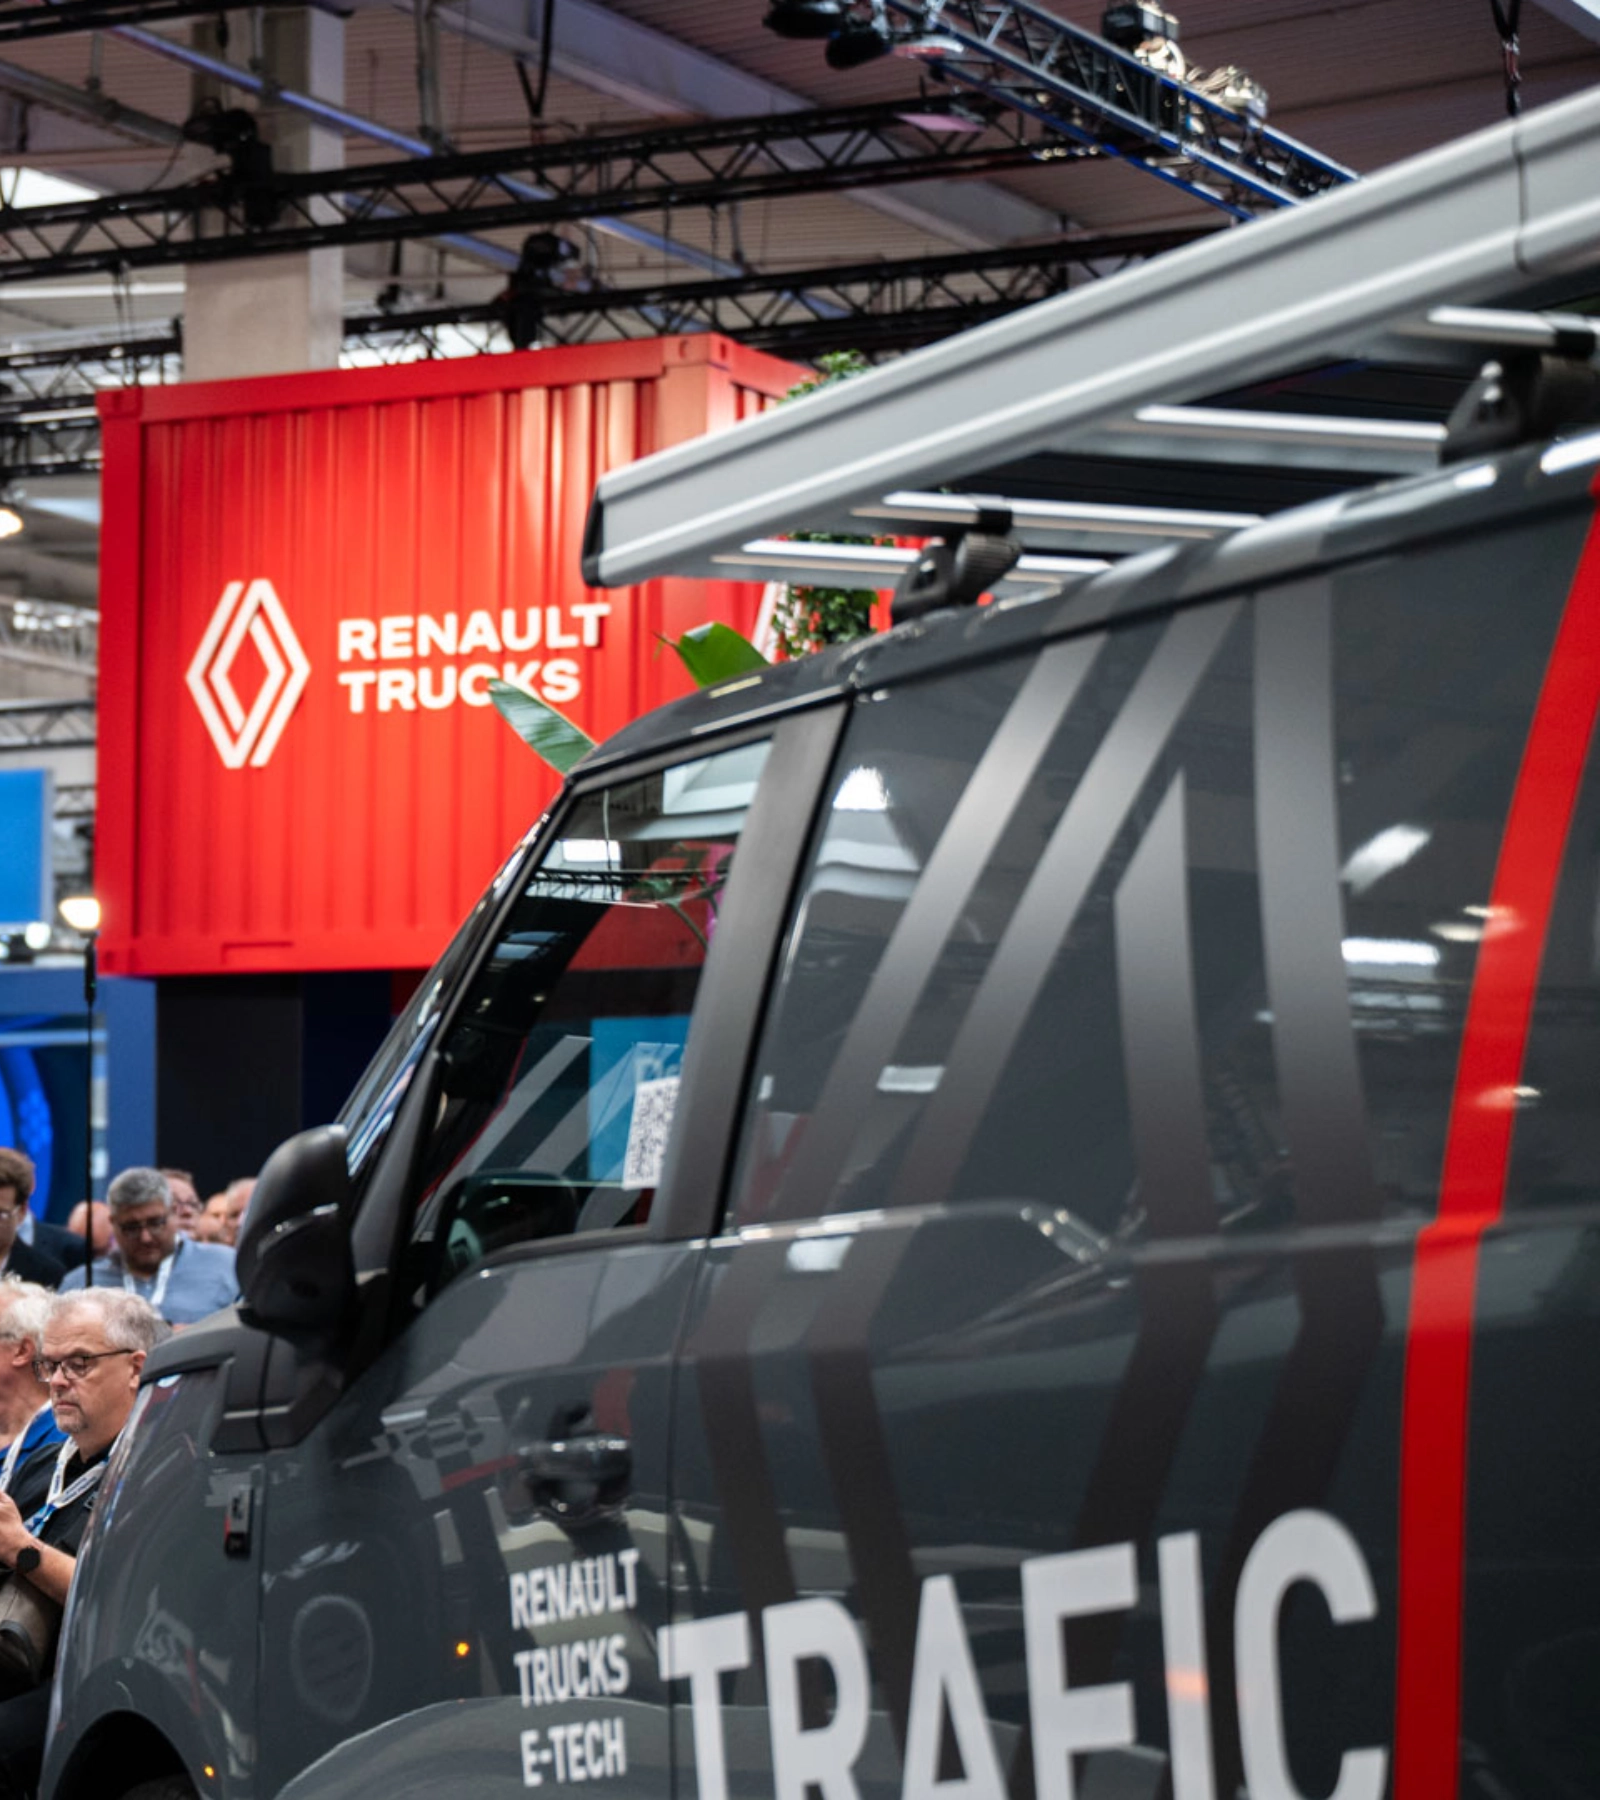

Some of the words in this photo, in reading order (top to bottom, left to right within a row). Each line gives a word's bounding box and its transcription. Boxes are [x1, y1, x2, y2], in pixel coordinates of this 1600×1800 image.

[338, 603, 611, 662] RENAULT
[338, 658, 581, 713] TRUCKS
[510, 1549, 639, 1630] RENAULT
[513, 1634, 630, 1708] TRUCKS
[657, 1507, 1388, 1800] TRAFIC
[520, 1716, 627, 1788] E-TECH
